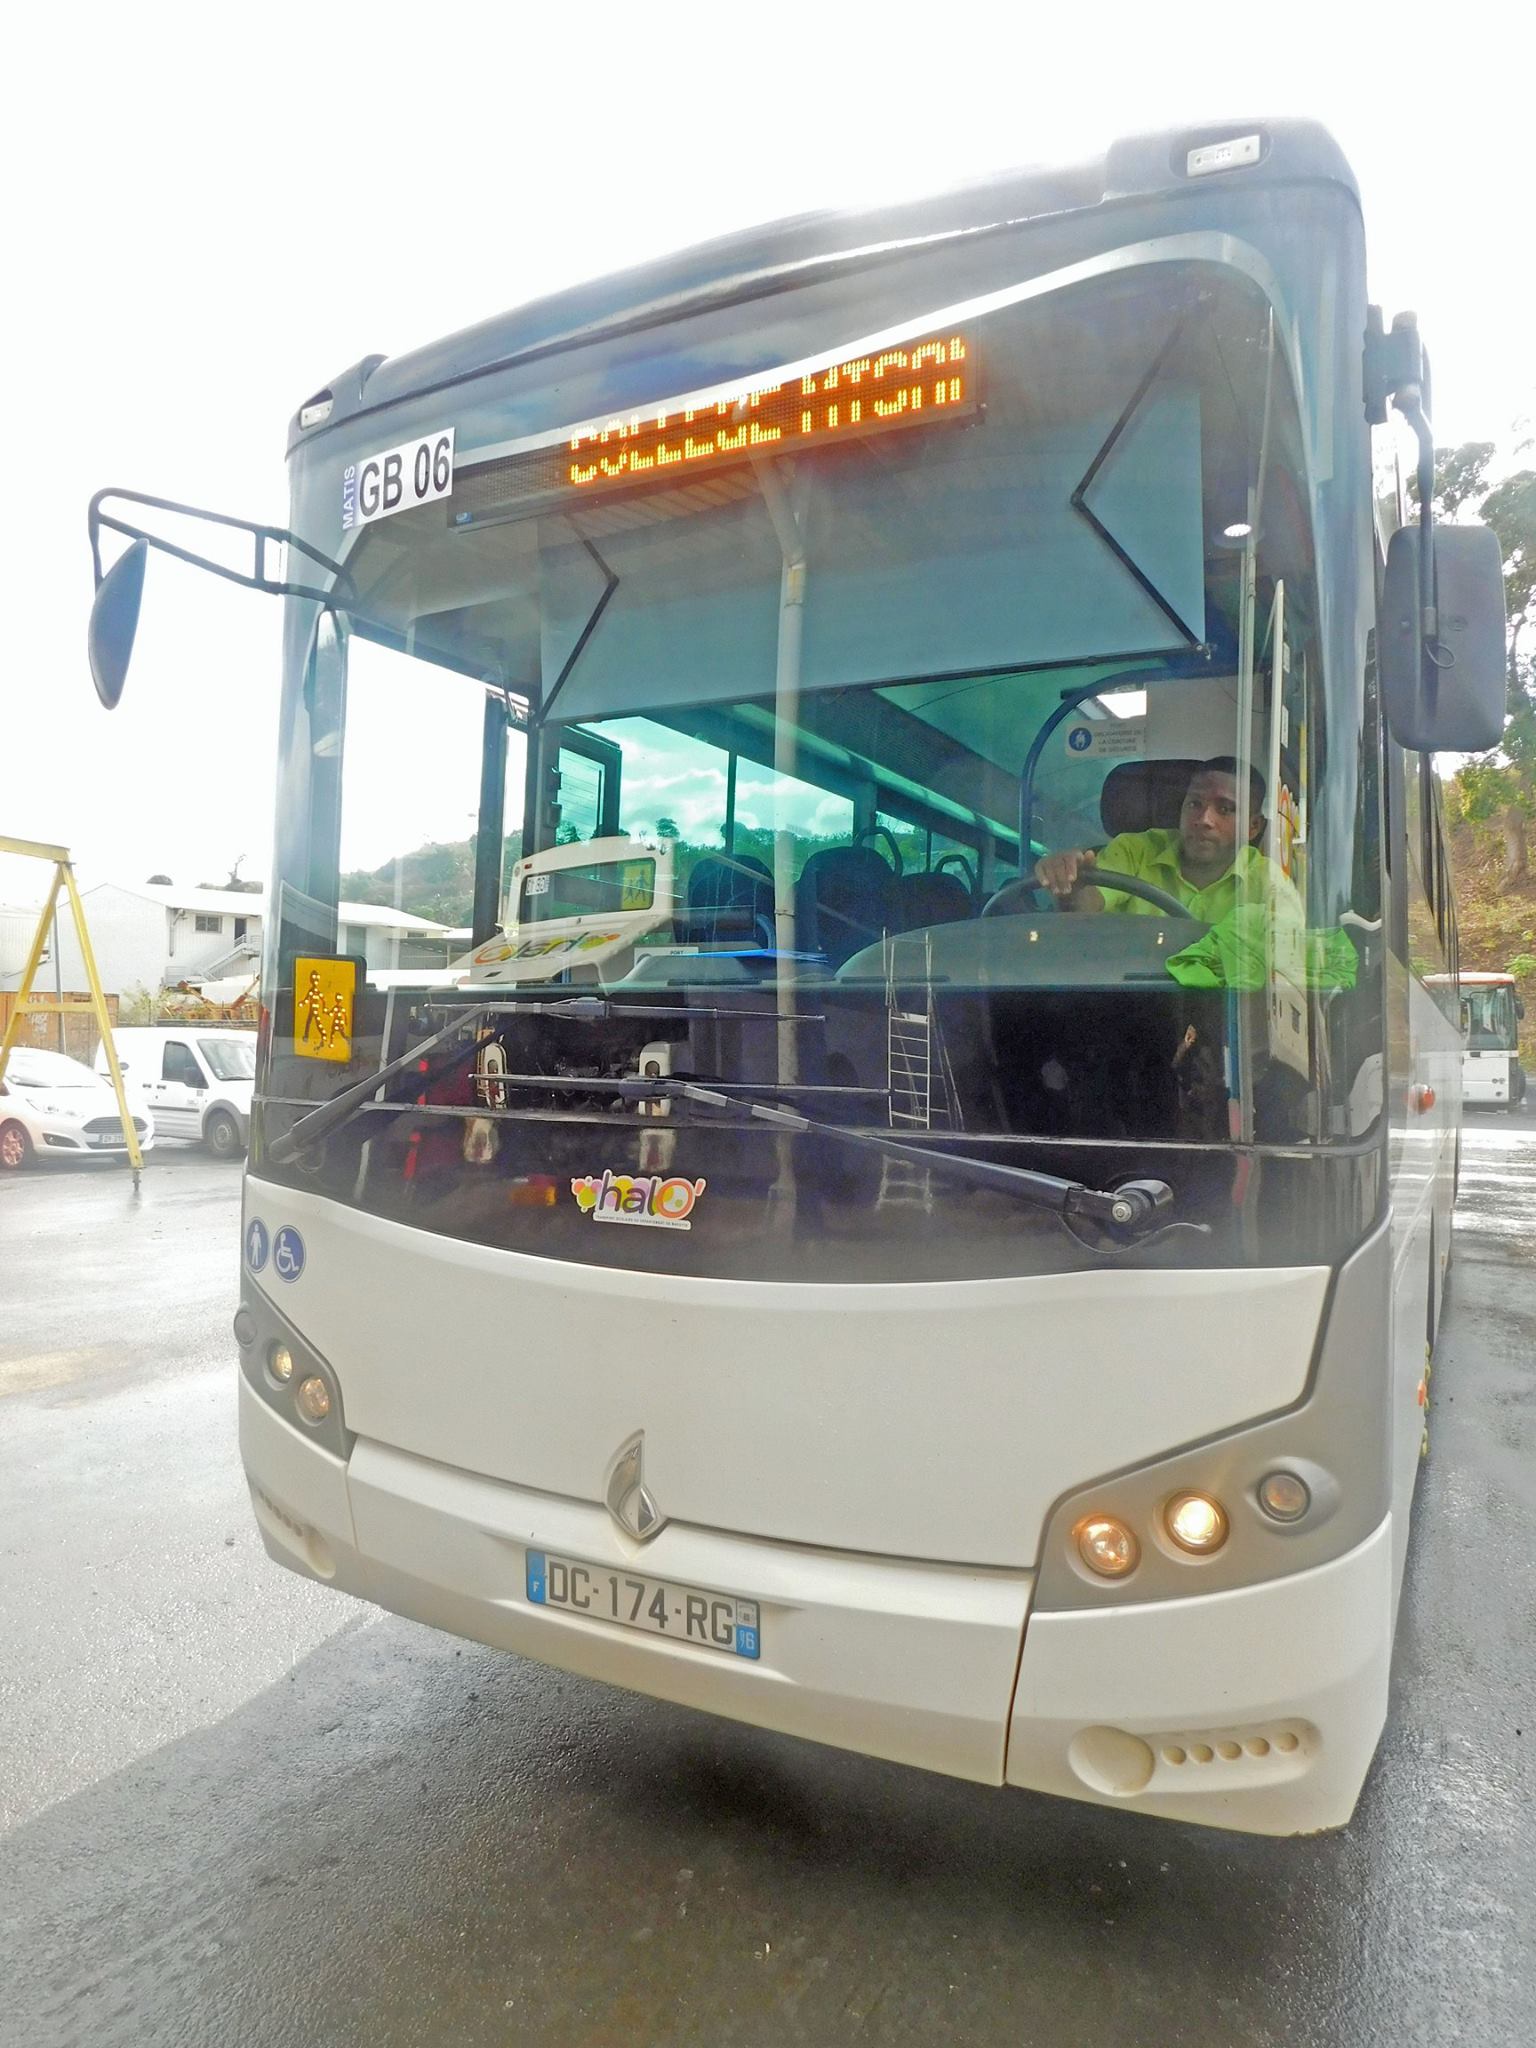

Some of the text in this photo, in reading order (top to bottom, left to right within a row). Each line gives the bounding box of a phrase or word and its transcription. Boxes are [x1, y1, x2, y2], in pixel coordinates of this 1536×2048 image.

[342, 465, 355, 531] MATIS
[359, 436, 451, 518] GB 06
